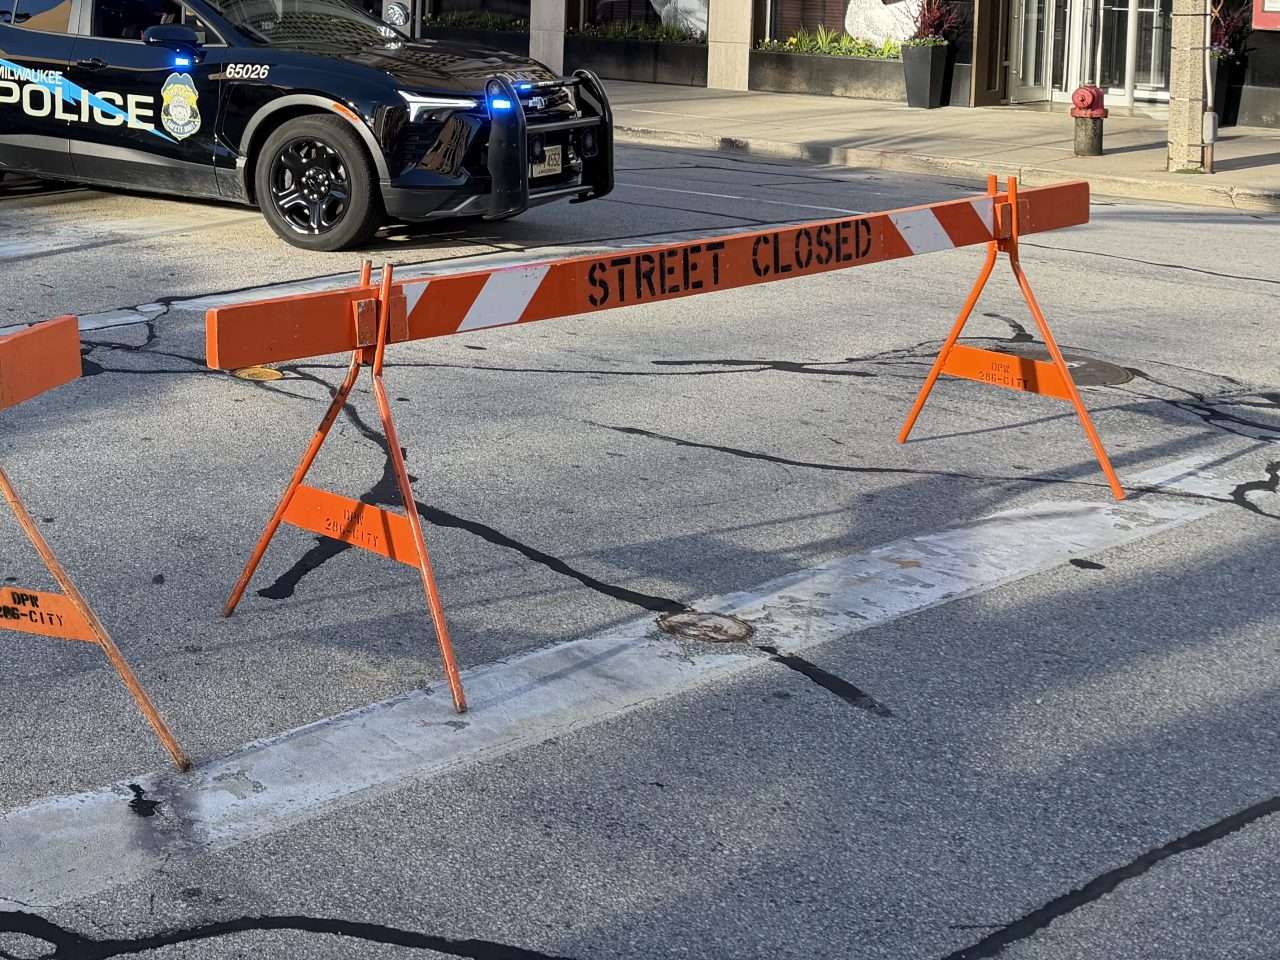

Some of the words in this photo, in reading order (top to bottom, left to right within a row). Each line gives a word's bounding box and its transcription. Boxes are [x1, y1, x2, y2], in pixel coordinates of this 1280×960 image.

[225, 63, 270, 79] 65026
[588, 242, 726, 308] STREET
[752, 218, 872, 278] CLOSED
[11, 591, 39, 608] DPW
